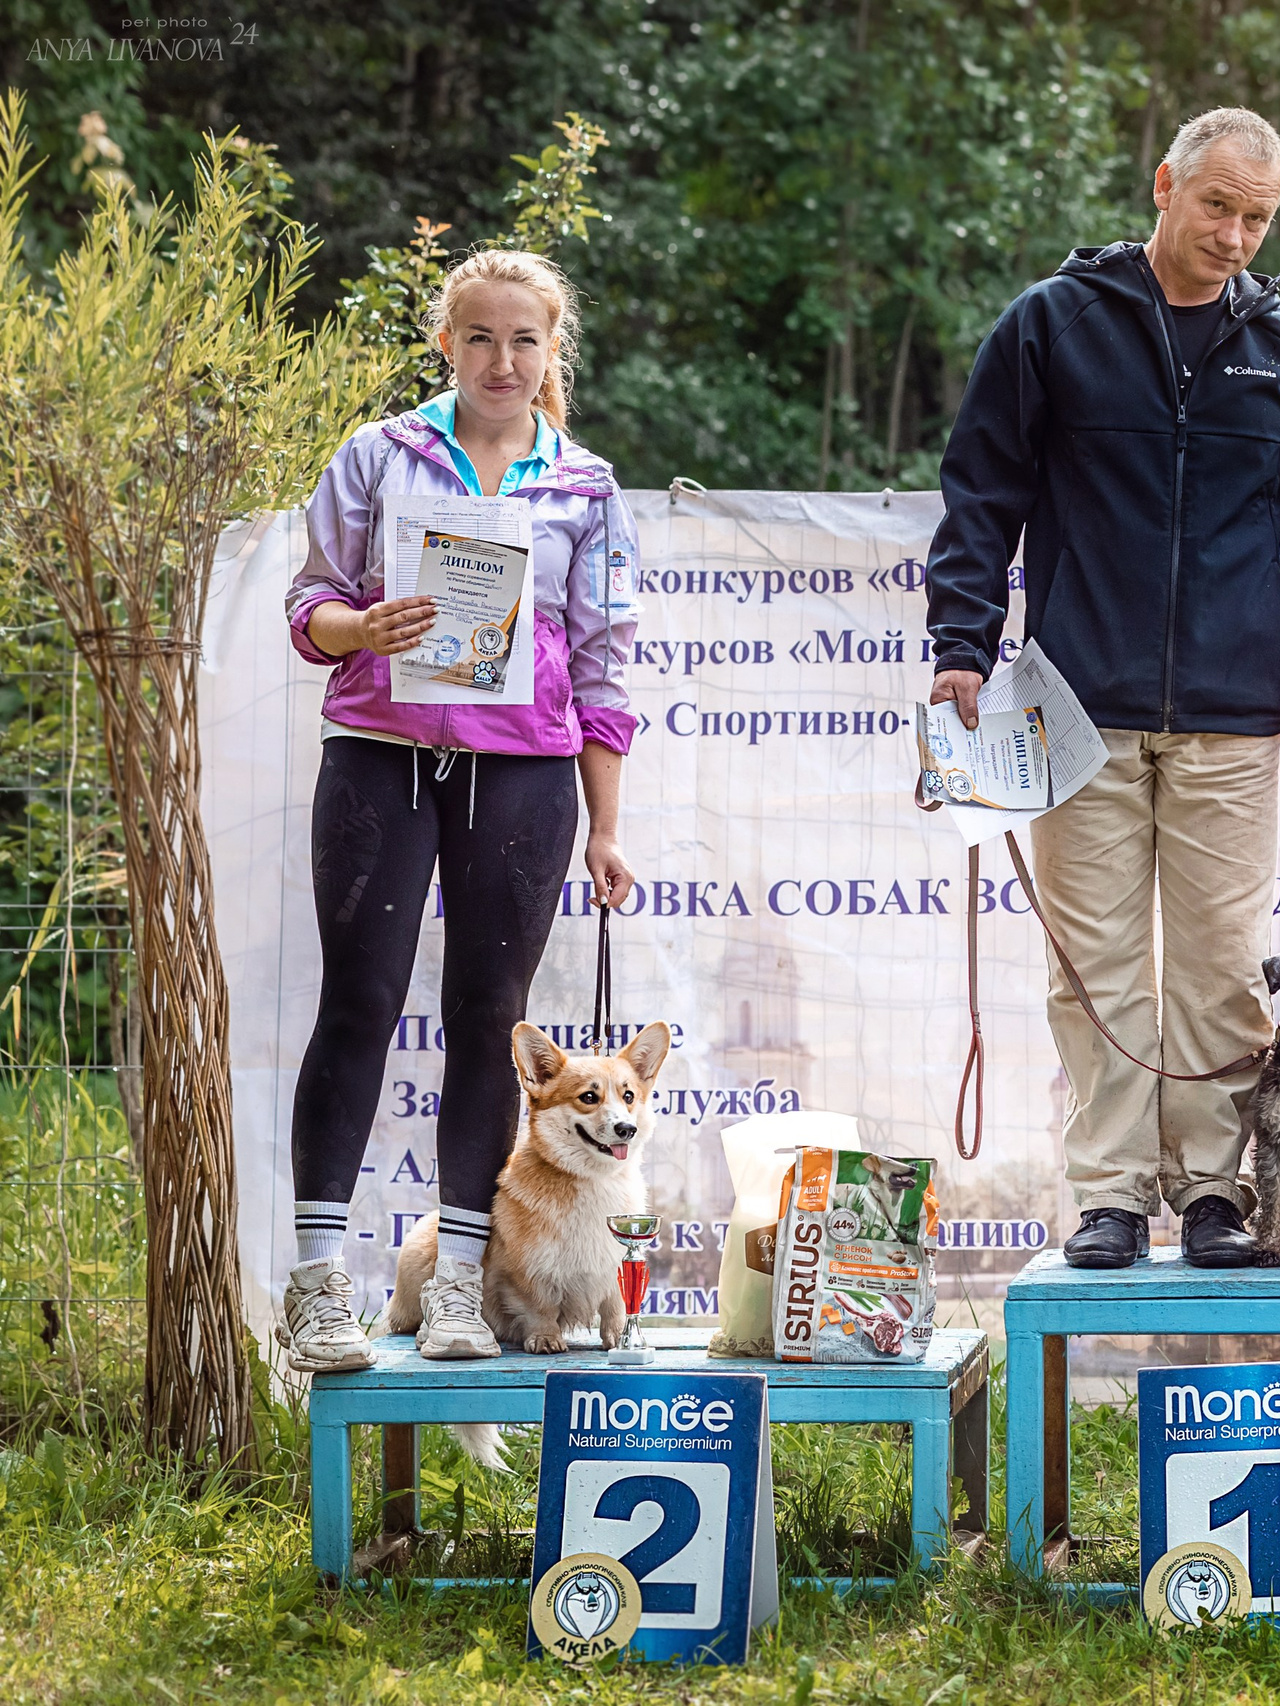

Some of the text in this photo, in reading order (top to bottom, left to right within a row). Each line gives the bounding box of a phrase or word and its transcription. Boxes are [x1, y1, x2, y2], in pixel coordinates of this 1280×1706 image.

[1234, 366, 1277, 378] Columbia
[440, 554, 504, 576] ДИПЛОМ
[447, 586, 488, 599] Награждается
[638, 567, 854, 604] конкурсов
[789, 629, 905, 664] «Мой
[1012, 729, 1030, 790] ДИПЛОМ
[768, 878, 950, 916] СОБАК
[803, 1185, 825, 1195] ADULT
[833, 1219, 855, 1230] 44%
[673, 1223, 701, 1249] к
[835, 1244, 873, 1254] ЯГНЕНОК
[457, 1261, 477, 1269] adidas
[842, 1254, 872, 1262] РИСОМ
[307, 1262, 329, 1272] adidas
[784, 1223, 823, 1342] SIRIUS
[783, 1344, 811, 1352] PREMIUM
[1164, 1426, 1216, 1441] Natural
[568, 1433, 732, 1451] Natural Superpremium
[593, 1475, 701, 1615] 2
[553, 1636, 617, 1657] АКЕЛА
